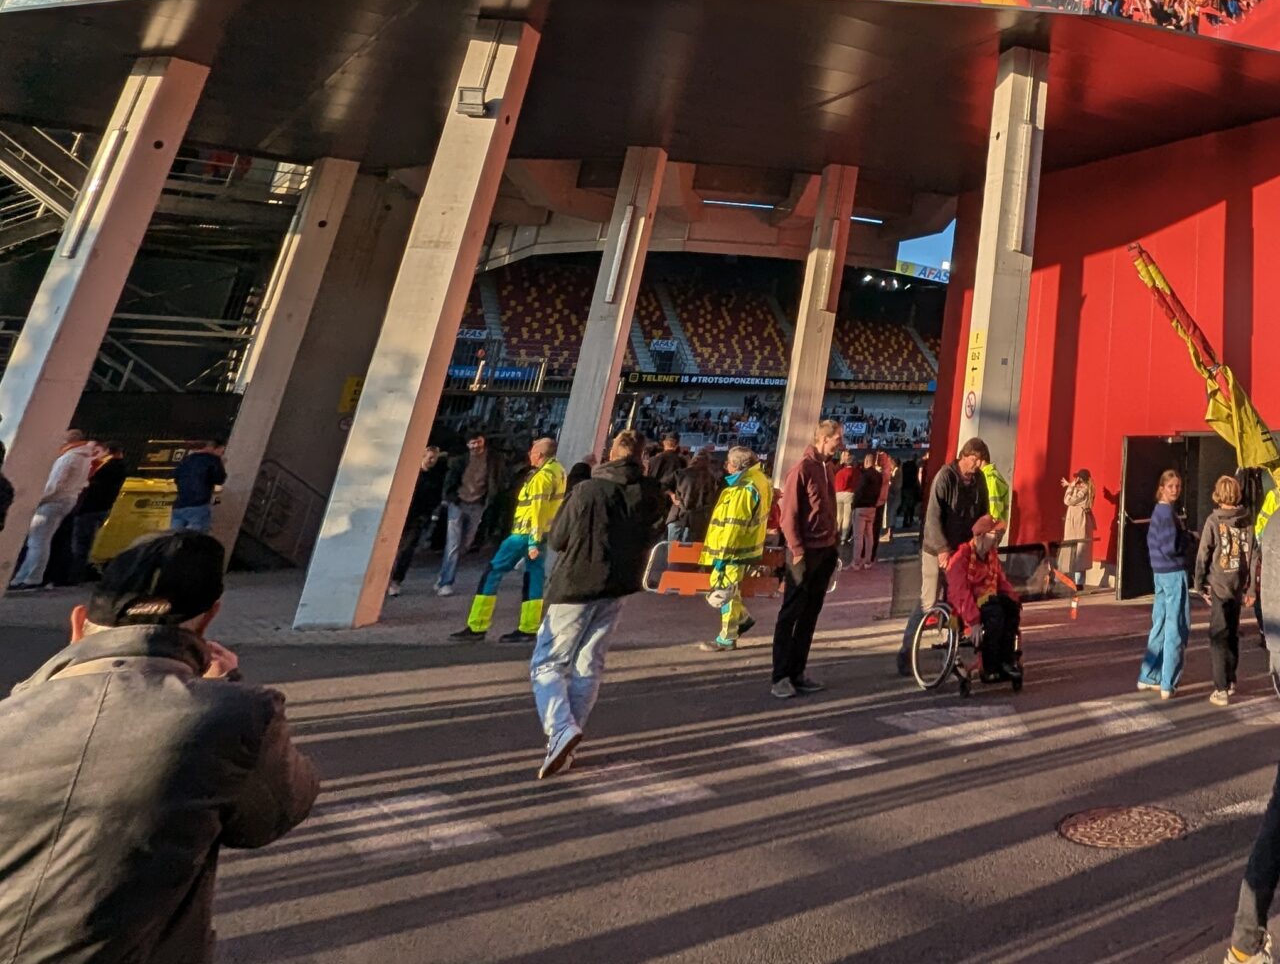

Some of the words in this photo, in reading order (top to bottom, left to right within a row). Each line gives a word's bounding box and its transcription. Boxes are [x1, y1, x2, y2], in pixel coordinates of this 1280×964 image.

[919, 267, 949, 282] AFAS
[642, 374, 680, 383] TELENET
[681, 375, 689, 383] IS
